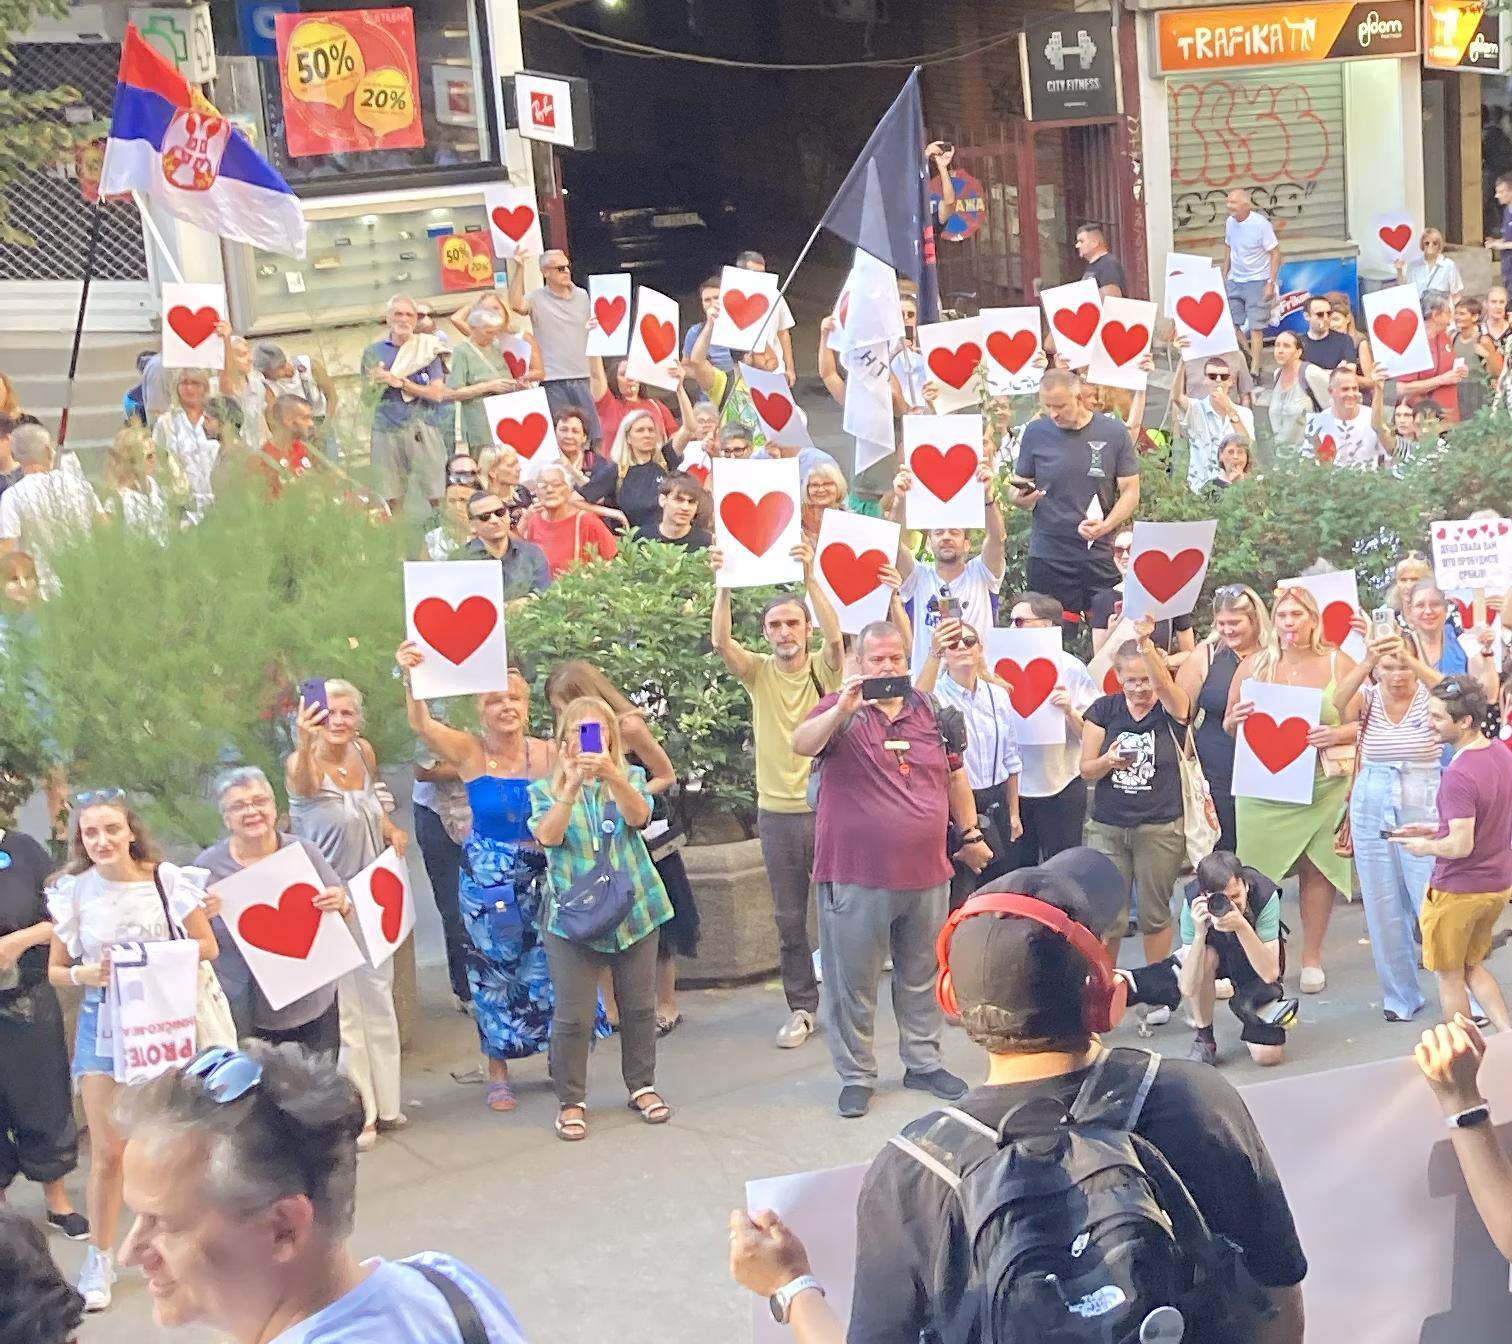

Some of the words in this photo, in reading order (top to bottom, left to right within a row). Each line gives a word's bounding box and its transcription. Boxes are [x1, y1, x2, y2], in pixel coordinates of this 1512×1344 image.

[1177, 22, 1285, 61] TRAFIKA
[1358, 10, 1403, 48] ploom
[296, 40, 356, 85] 50%
[360, 87, 407, 111] 20%
[1046, 79, 1065, 92] CITY
[1066, 77, 1100, 92] FITNESS
[930, 197, 986, 214] ГАЖА
[124, 1038, 194, 1068] PROTE
